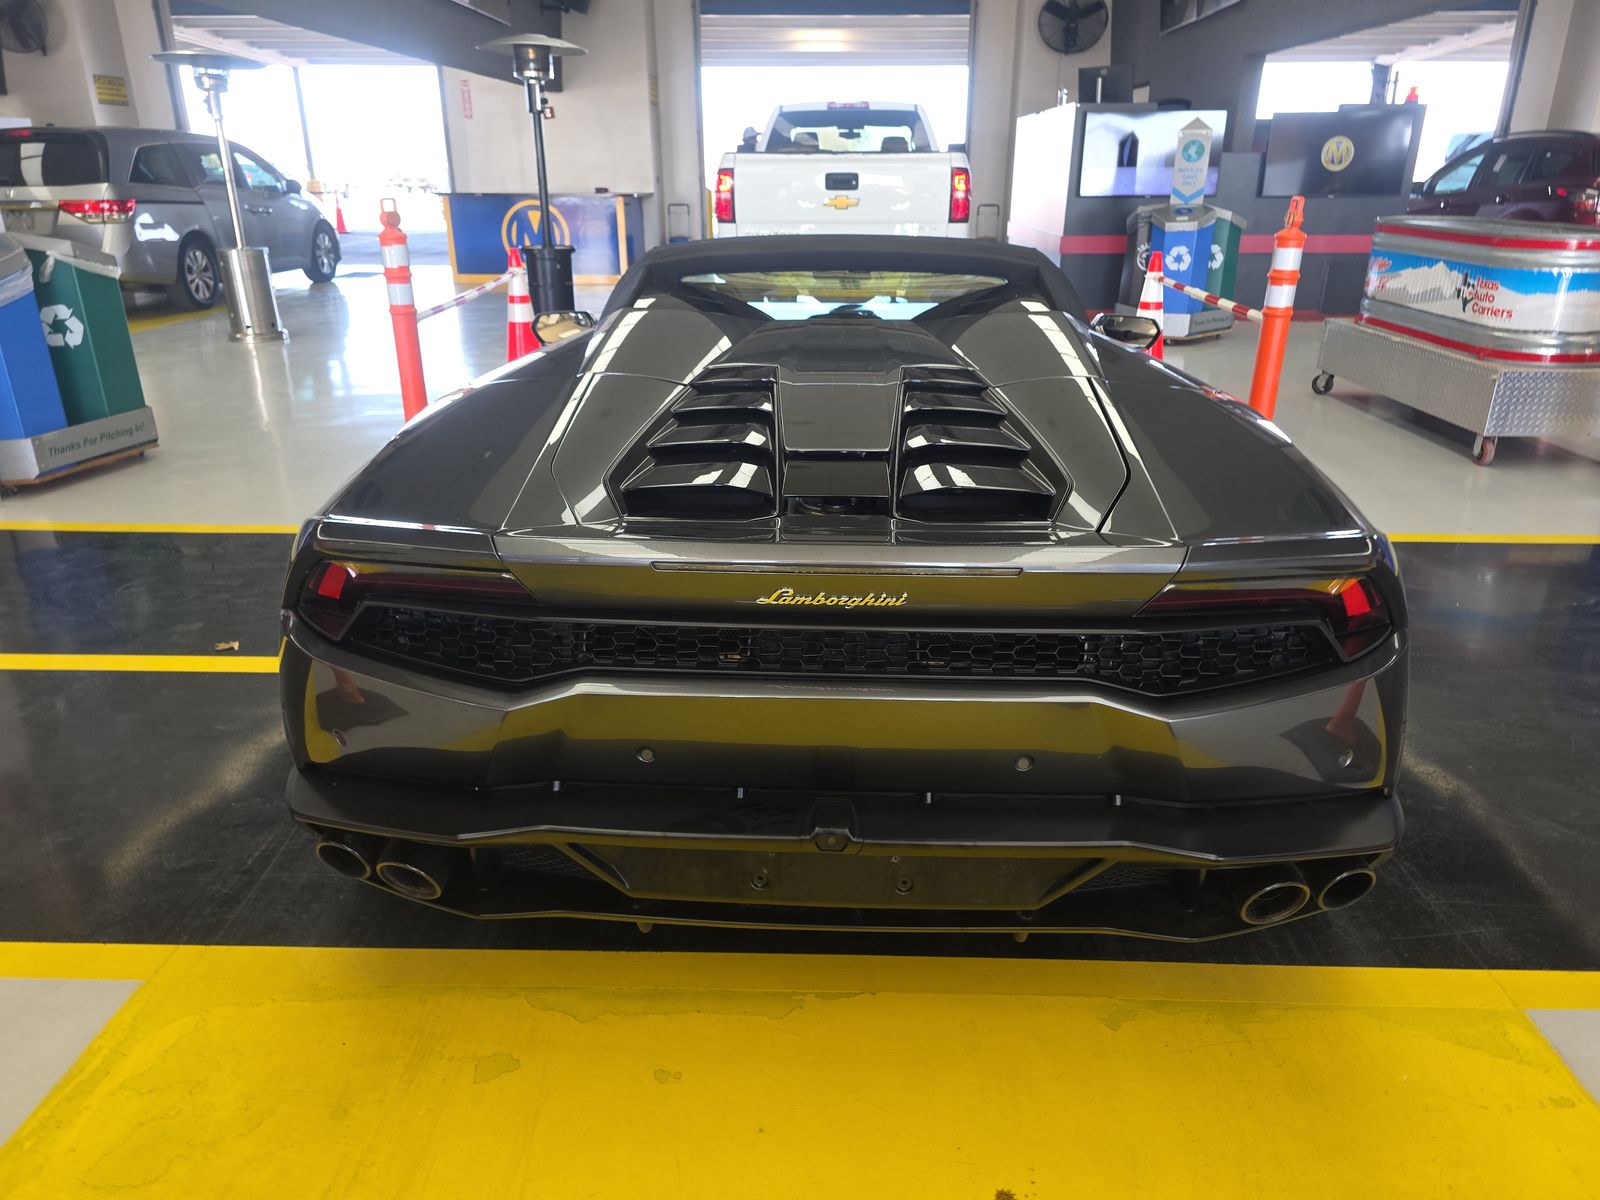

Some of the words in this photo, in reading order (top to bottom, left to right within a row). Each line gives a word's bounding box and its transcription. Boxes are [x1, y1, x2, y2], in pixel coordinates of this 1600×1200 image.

[1472, 303, 1513, 318] Carriers
[48, 440, 81, 458] Thanks
[82, 436, 98, 448] For
[100, 427, 133, 443] Pitching
[134, 422, 145, 433] In!
[755, 587, 908, 609] Lamborghini
